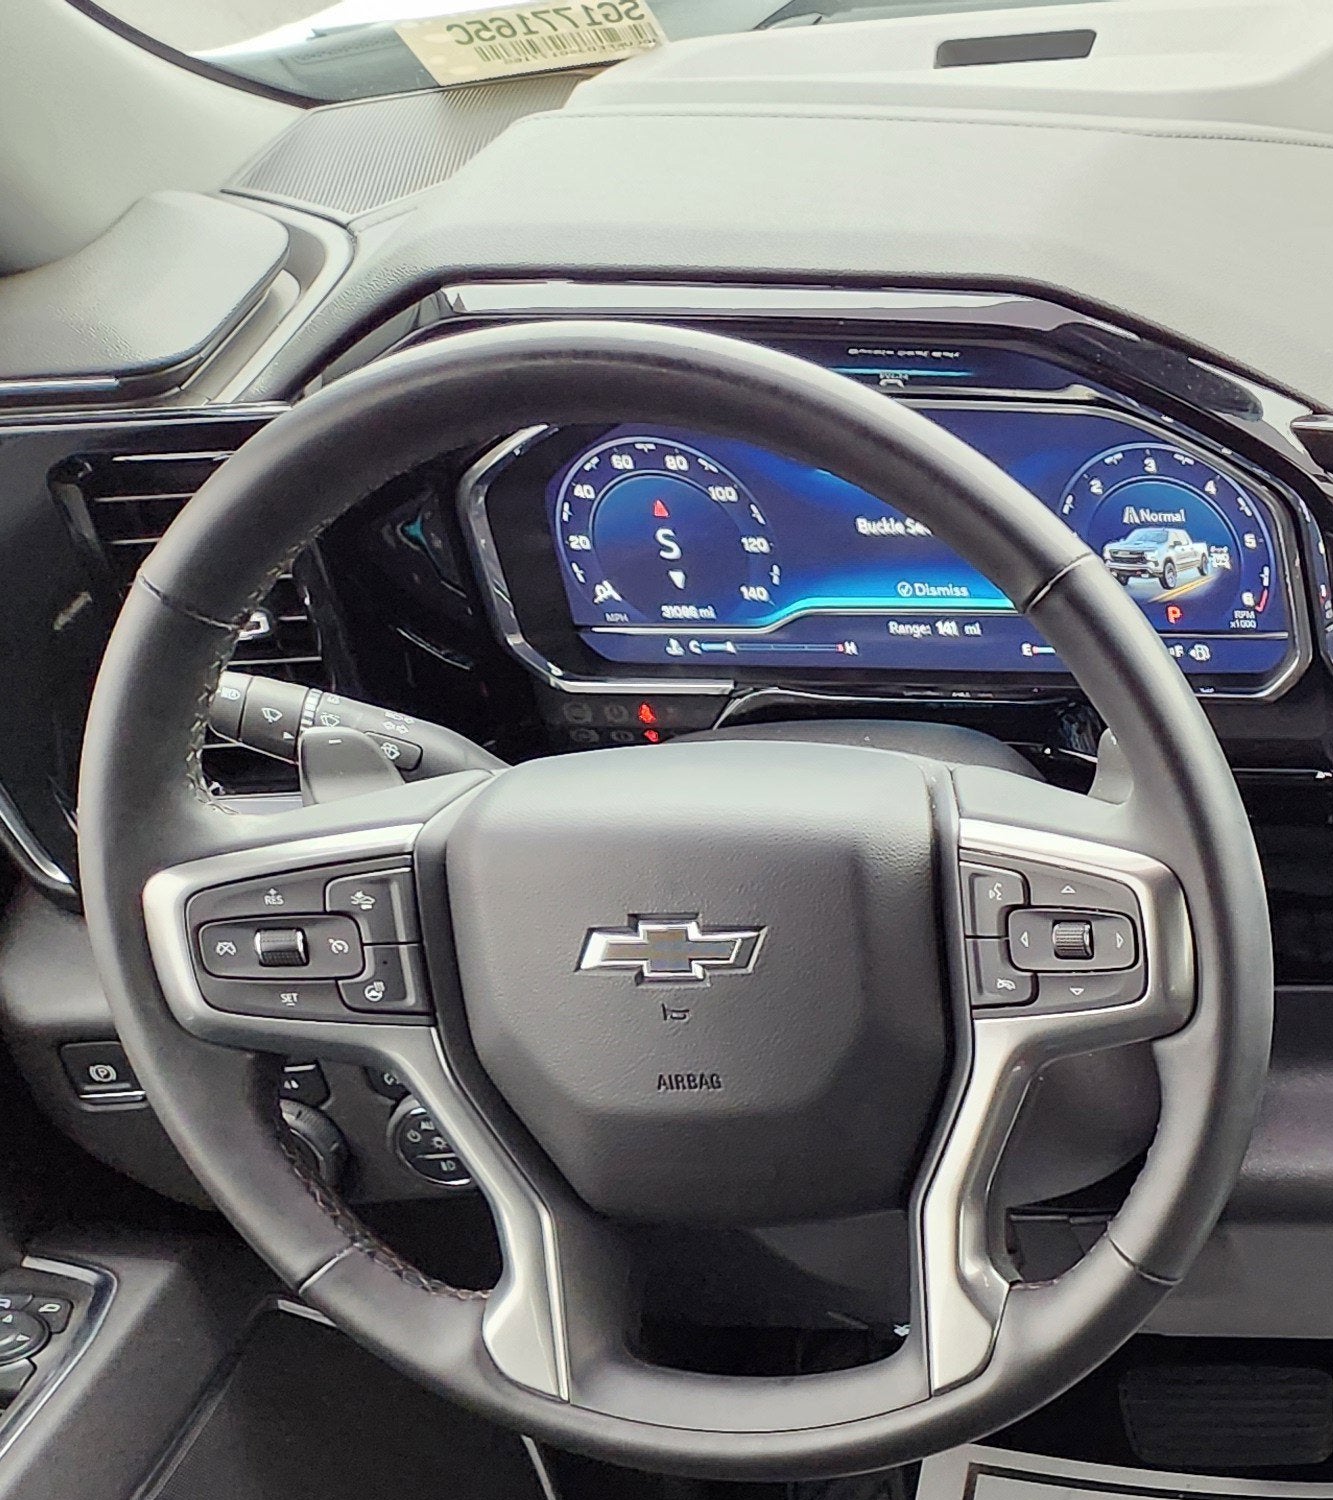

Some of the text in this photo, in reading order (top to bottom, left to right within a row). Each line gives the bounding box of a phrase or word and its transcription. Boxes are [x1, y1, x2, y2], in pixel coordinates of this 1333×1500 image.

[610, 454, 634, 470] 60
[664, 454, 689, 471] 80
[1143, 457, 1157, 474] 3
[573, 484, 596, 499] 40
[708, 486, 739, 502] 100
[1089, 478, 1104, 495] 2
[1204, 480, 1217, 495] 4
[1140, 509, 1186, 523] Normal
[855, 516, 907, 537] Buckle
[567, 534, 592, 550] 20
[655, 528, 682, 560] S
[741, 537, 772, 554] 120
[1243, 533, 1257, 549] 5
[740, 585, 770, 601] 140
[914, 583, 970, 597] Dismiss
[606, 612, 629, 623] MPH
[699, 605, 717, 619] mi
[1166, 605, 1182, 624] P
[1233, 610, 1256, 619] RPM
[888, 620, 932, 639] Range:
[964, 622, 982, 636] mi
[264, 894, 284, 906] RES
[280, 992, 299, 1003] SET
[657, 1072, 723, 1091] AIRBAG
